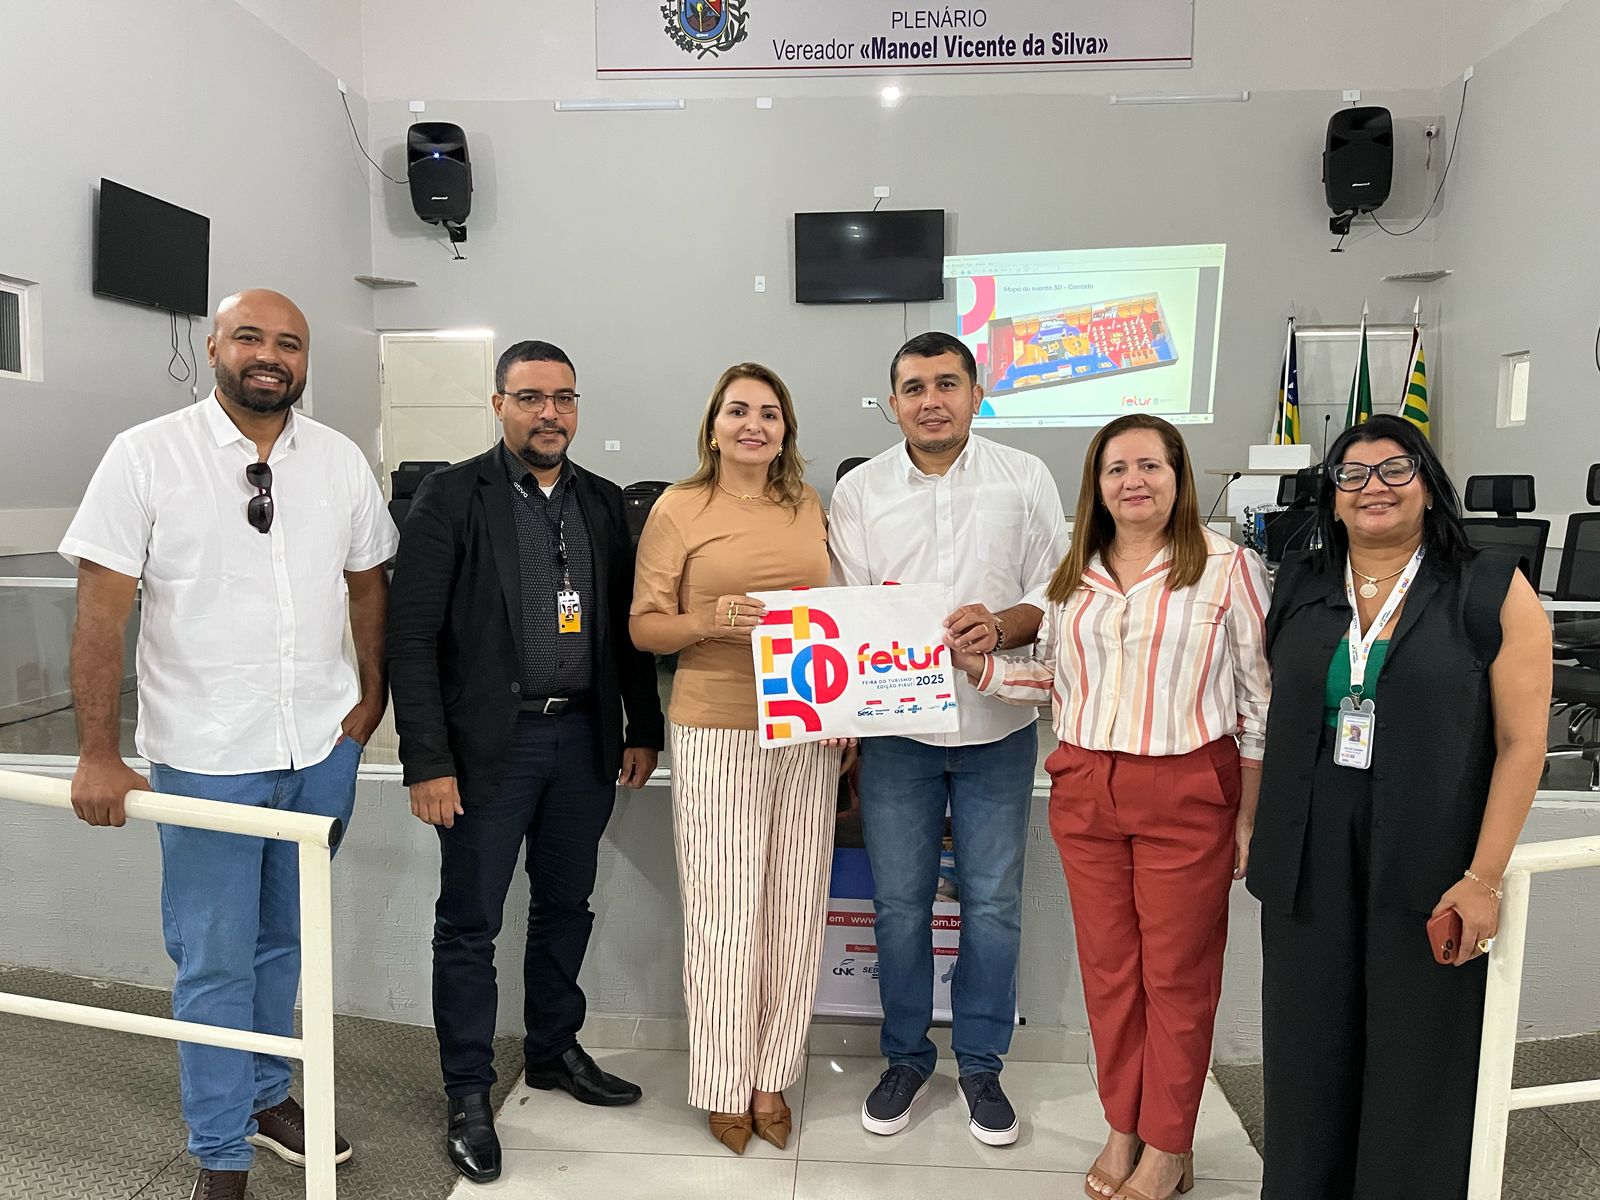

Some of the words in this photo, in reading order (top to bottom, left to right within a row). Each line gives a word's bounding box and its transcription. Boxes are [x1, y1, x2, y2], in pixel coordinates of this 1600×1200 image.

[891, 6, 987, 29] PLENÁRIO
[773, 39, 854, 61] Vereador
[943, 34, 1017, 58] Vicente
[1022, 33, 1046, 56] da
[1003, 285, 1022, 293] Mapa
[1053, 283, 1063, 291] 3D
[1121, 395, 1152, 407] fetur
[513, 481, 528, 498] ativa
[857, 641, 945, 675] fetur
[916, 674, 945, 686] 2025
[829, 914, 844, 923] em
[930, 918, 961, 928] om.br
[862, 966, 879, 974] SEB
